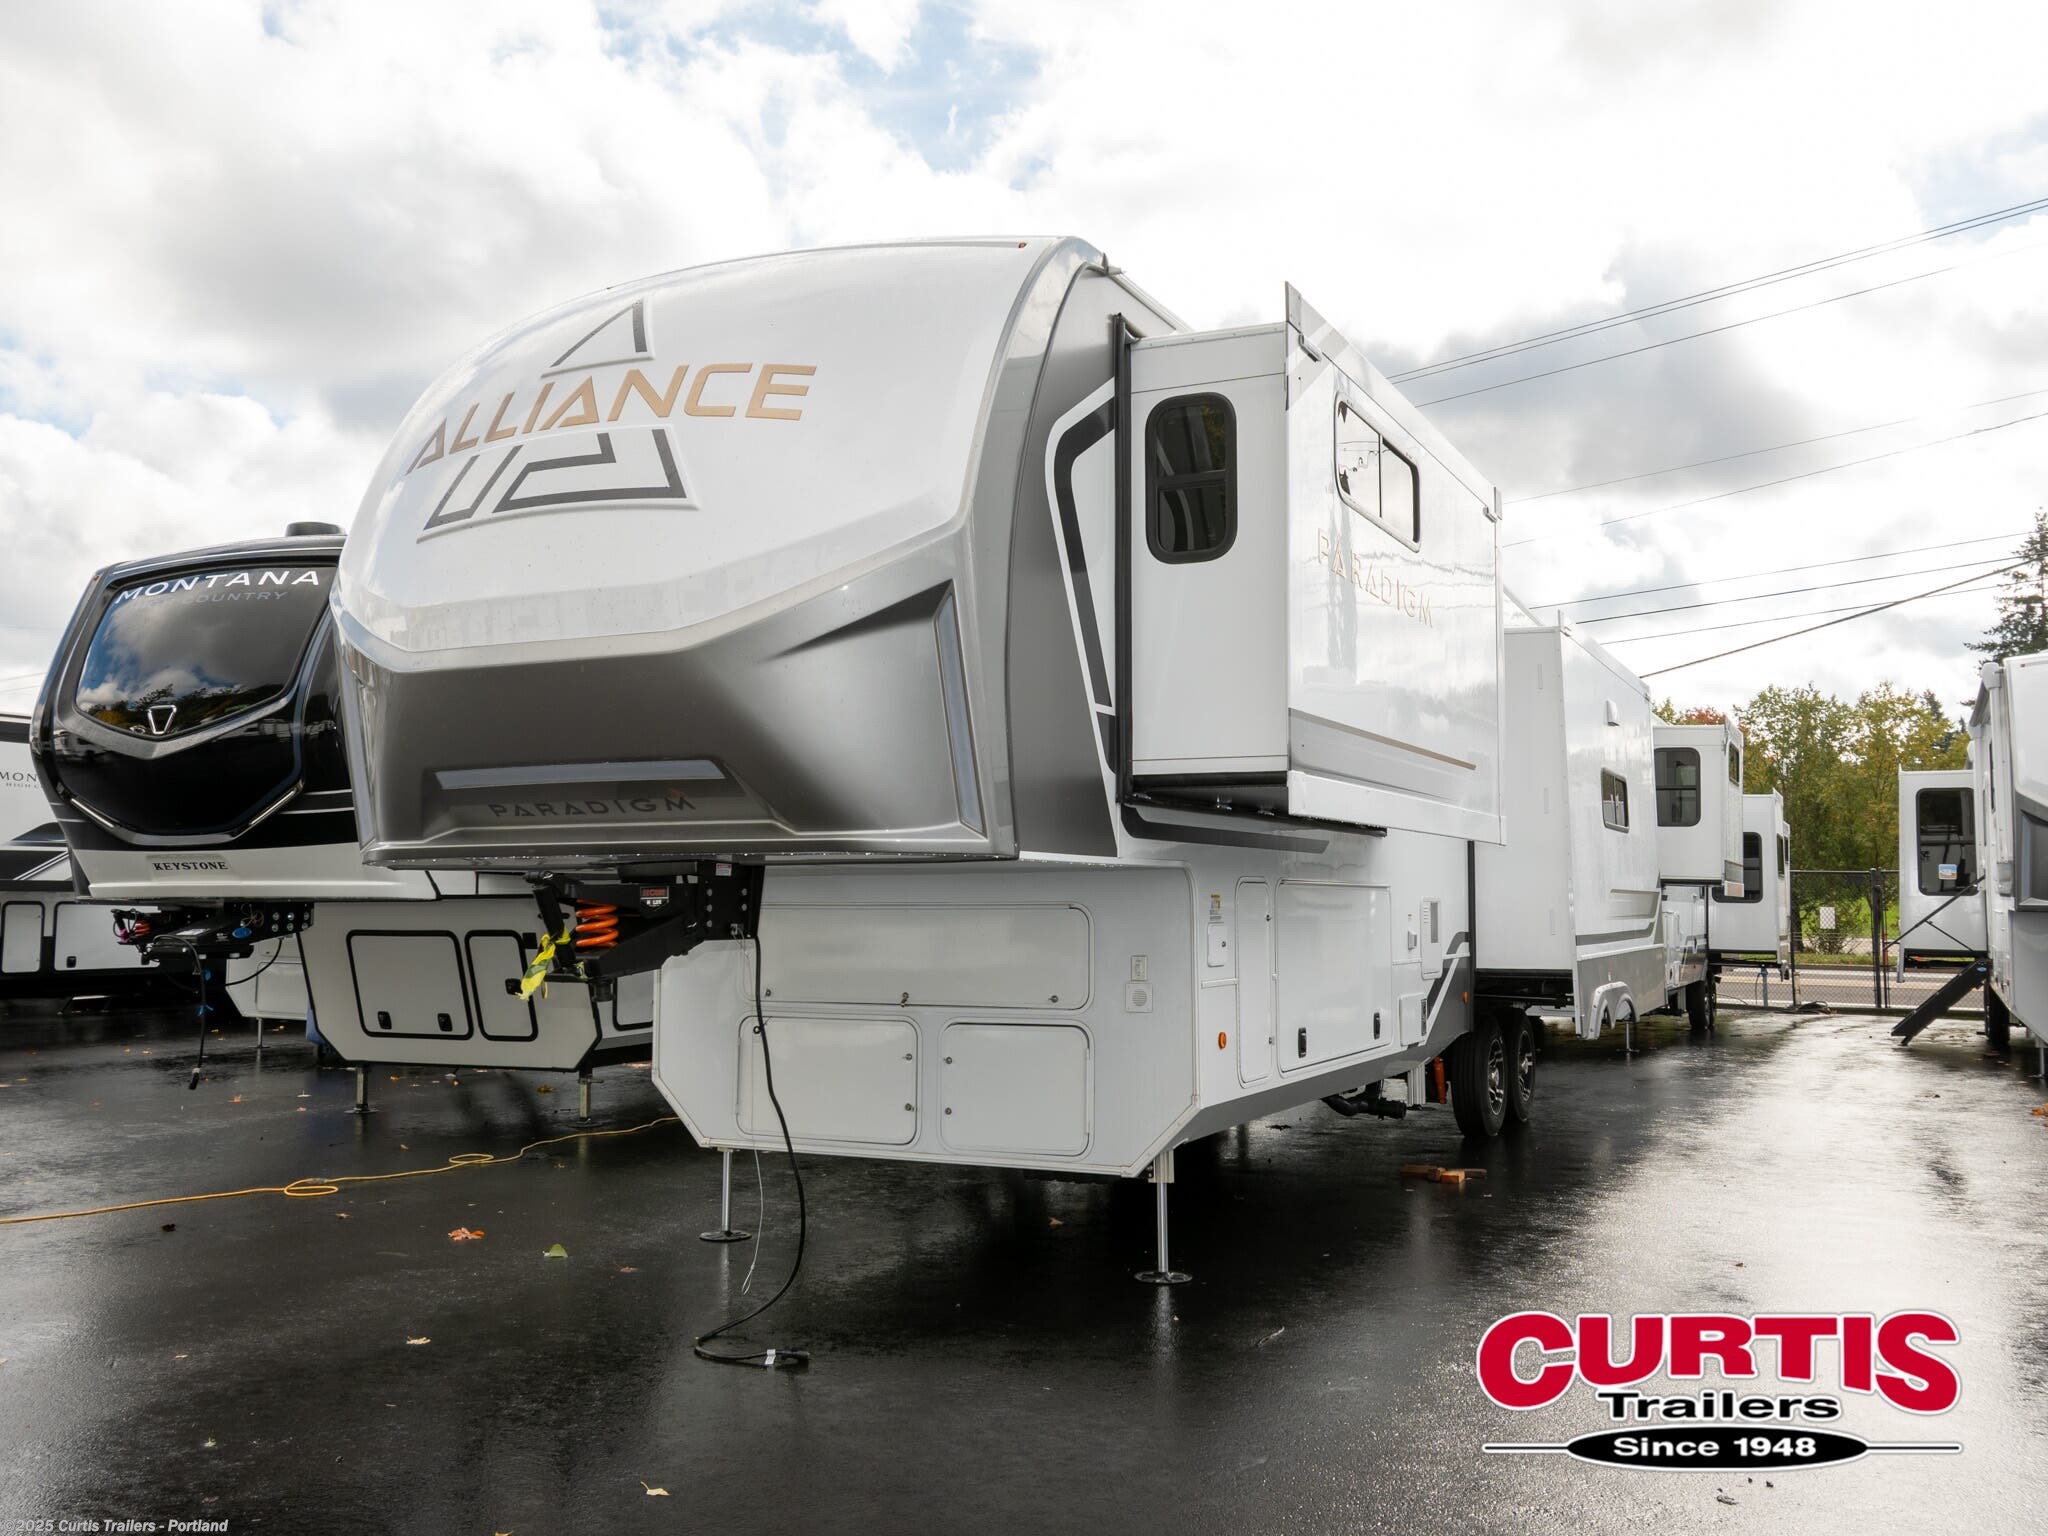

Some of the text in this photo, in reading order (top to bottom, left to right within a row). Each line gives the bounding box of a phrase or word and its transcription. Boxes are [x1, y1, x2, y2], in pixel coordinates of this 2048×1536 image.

[405, 363, 818, 475] ALLIANCE
[115, 570, 320, 604] MONTANA
[1317, 527, 1433, 628] PARADIGM
[487, 796, 697, 817] PARADIGM
[153, 861, 229, 871] KEYSTONE
